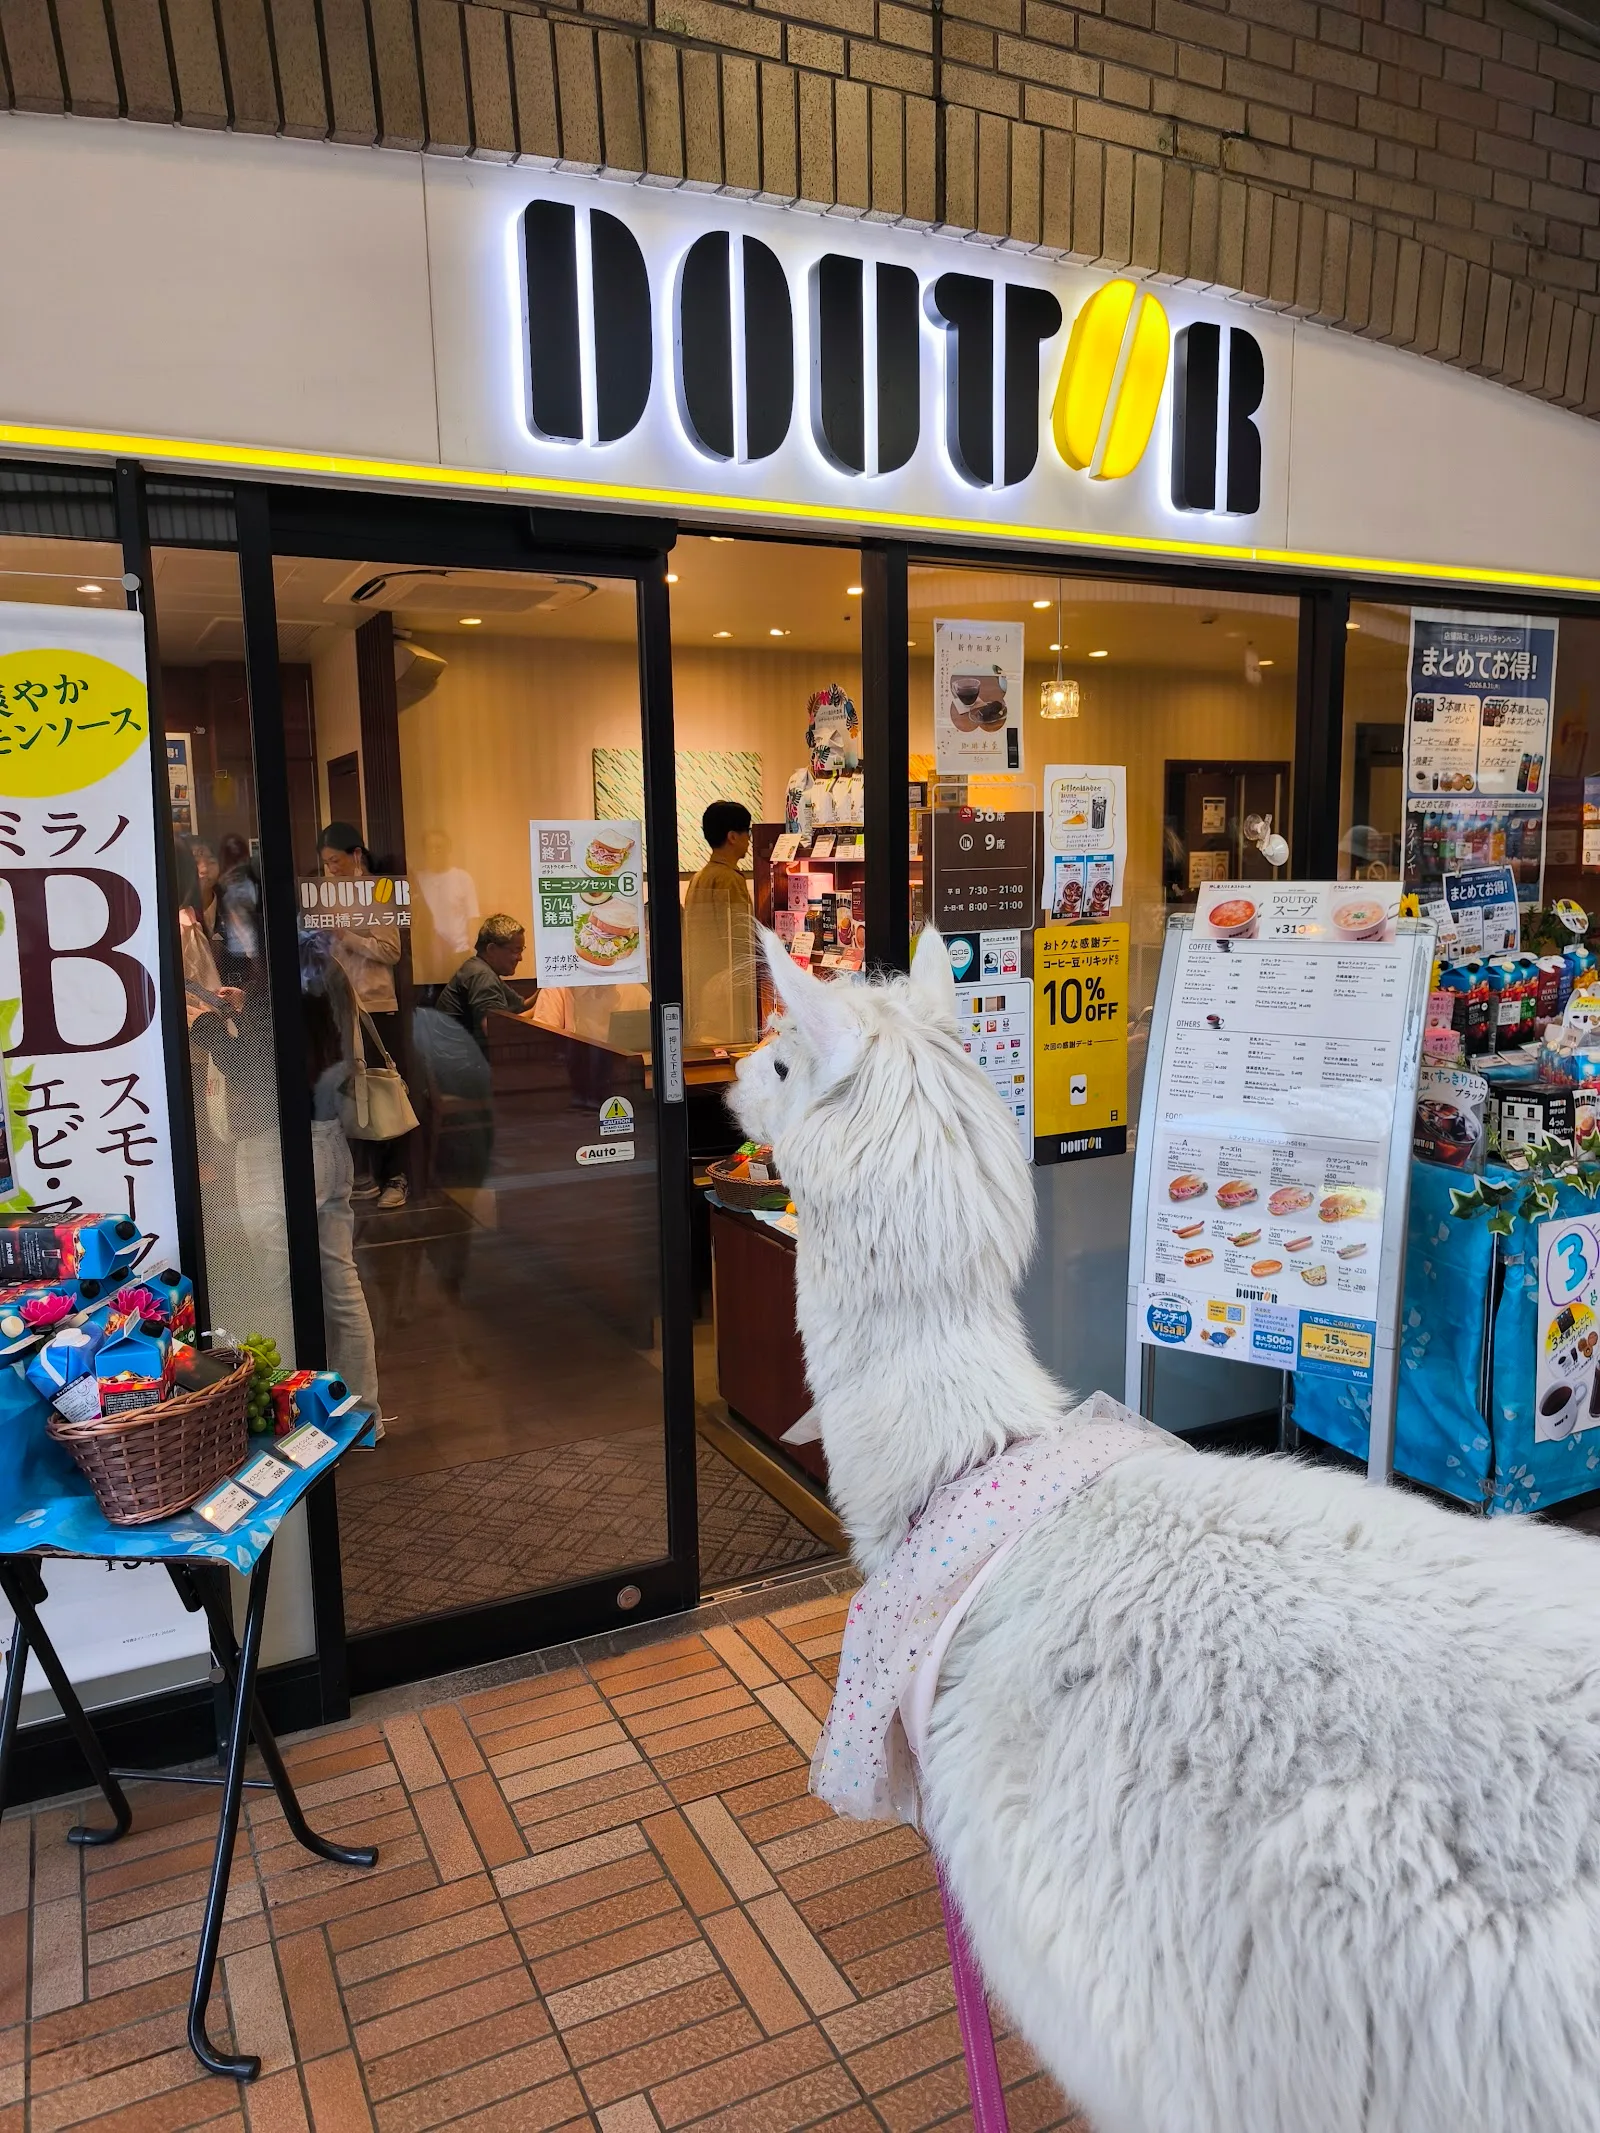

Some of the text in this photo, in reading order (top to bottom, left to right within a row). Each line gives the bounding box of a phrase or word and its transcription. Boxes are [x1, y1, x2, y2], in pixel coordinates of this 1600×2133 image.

[521, 199, 1264, 517] DOUTOR
[1421, 646, 1538, 681] まとめてお得!
[0, 811, 130, 858] ミラノ
[541, 832, 568, 847] 5/13
[541, 846, 569, 861] 終了
[541, 876, 635, 892] モーニングセット B
[969, 886, 988, 896] 7:30
[999, 884, 1023, 894] 21:00
[1450, 880, 1509, 902] まとめてお得!
[301, 877, 411, 909] DOUTOR
[1272, 895, 1318, 905] DOUTOR
[543, 897, 571, 911] 5/14
[969, 902, 988, 912] 8:00
[999, 900, 1023, 910] 21:00
[1273, 905, 1315, 917] スープ
[303, 911, 411, 929] 飯田橋ラムラ店
[544, 911, 572, 925] 発売
[1043, 937, 1120, 951] おトクな感謝デー
[1188, 943, 1212, 951] COFFEE
[0, 867, 157, 1059] B
[1043, 954, 1113, 970] コーヒー豆・リキッド
[1043, 976, 1119, 1026] 10% OFF
[1176, 1020, 1201, 1028] OTHERS
[1043, 1039, 1094, 1052] 次回の感謝デーは
[669, 1035, 679, 1087] 押して下さい
[1421, 1070, 1487, 1091] 深くすっきりとした
[1454, 1088, 1486, 1102] ブラック
[603, 1118, 631, 1126] CAUTION
[1111, 1109, 1119, 1122] 日
[1060, 1136, 1102, 1155] DOUTOR
[588, 1147, 617, 1159] Auto
[1557, 1232, 1588, 1292] 3
[1236, 1288, 1278, 1304] DOUTOR
[1152, 1308, 1178, 1321] タッチ
[1152, 1321, 1187, 1337] Visa割
[1255, 1332, 1293, 1346] 最大500円
[1324, 1333, 1348, 1347] 15%
[1305, 1341, 1368, 1359] キャッシュバック!
[1352, 1369, 1369, 1379] VISA
[271, 1467, 286, 1480] ¥590
[235, 1498, 250, 1512] ¥590
